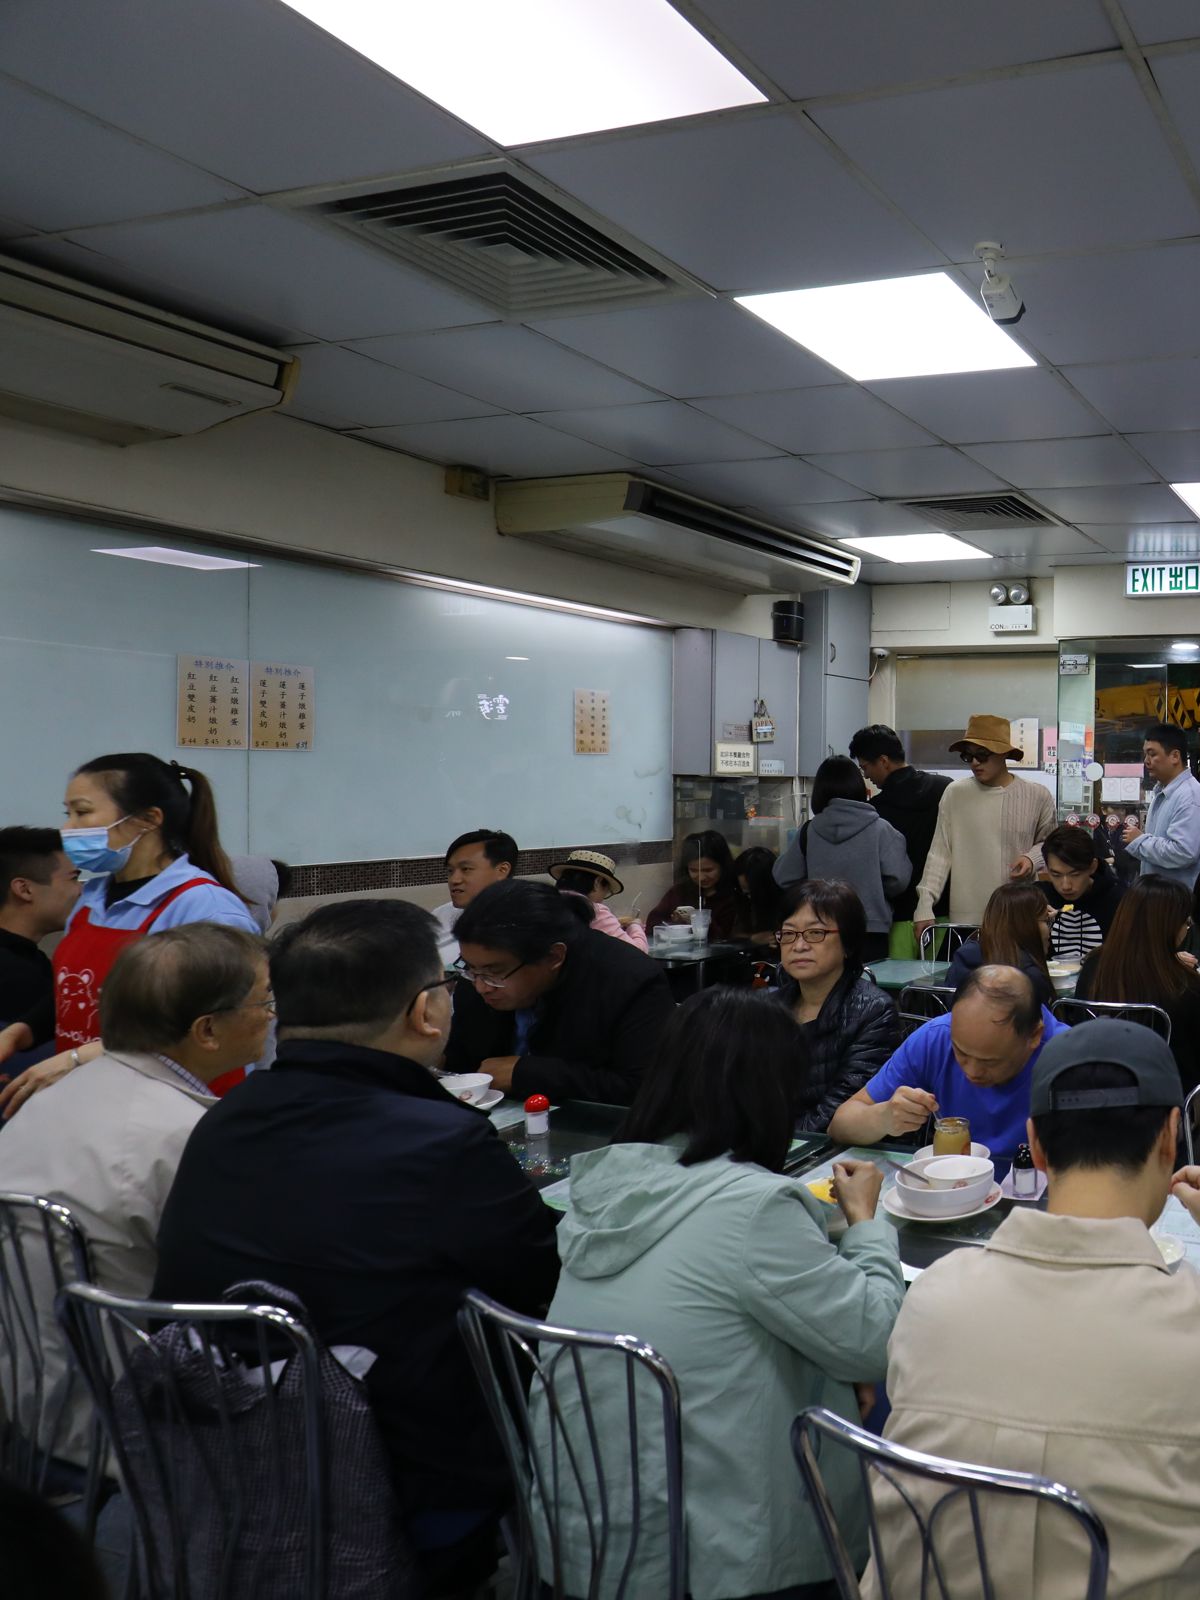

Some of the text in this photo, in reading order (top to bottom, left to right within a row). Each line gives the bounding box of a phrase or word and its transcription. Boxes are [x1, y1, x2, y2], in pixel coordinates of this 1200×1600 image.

[1131, 565, 1199, 592] EXIT 出口
[194, 660, 234, 671] 特別推介
[187, 672, 196, 723] 紅豆雙皮奶
